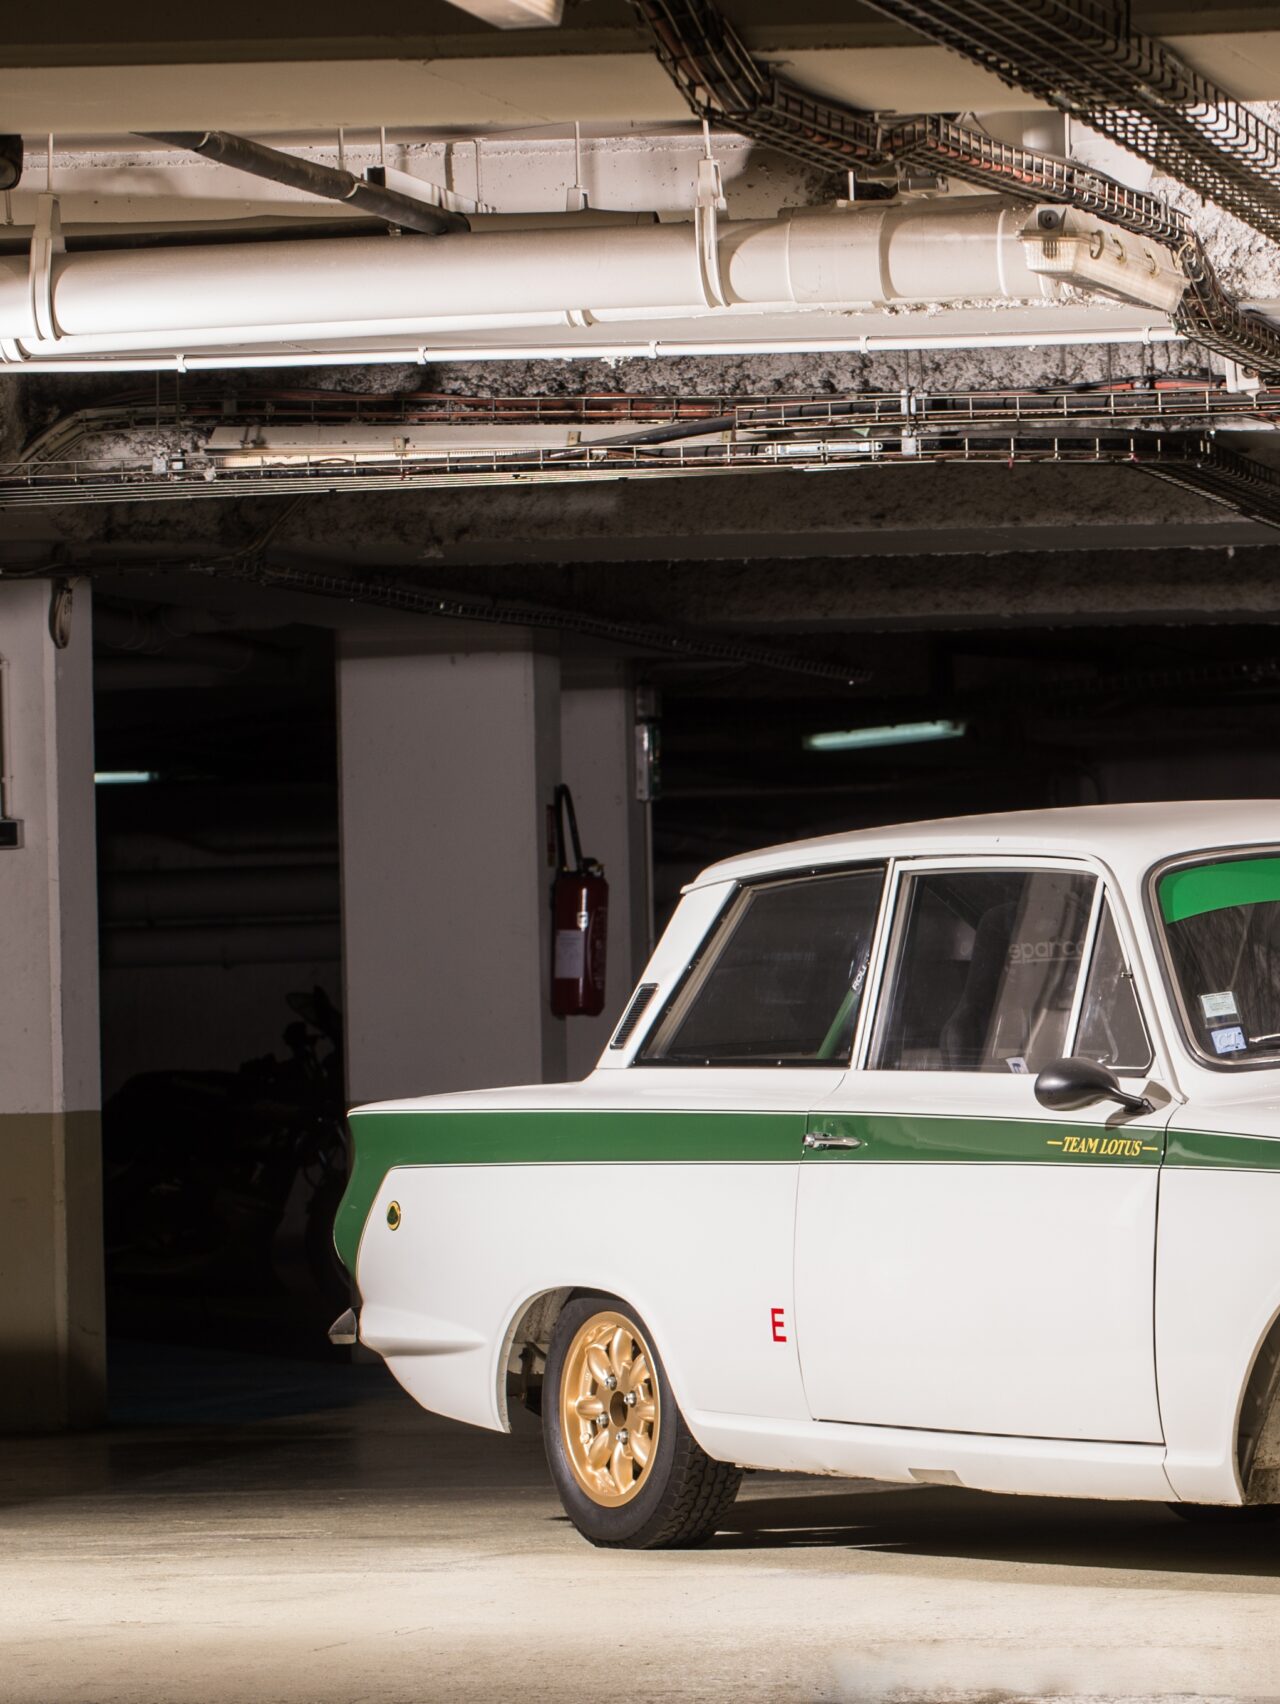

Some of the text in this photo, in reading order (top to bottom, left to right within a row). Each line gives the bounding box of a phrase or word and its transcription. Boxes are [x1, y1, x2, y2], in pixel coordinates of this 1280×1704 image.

[1062, 1136, 1143, 1156] TEAM LOTUS
[771, 1308, 787, 1342] E
